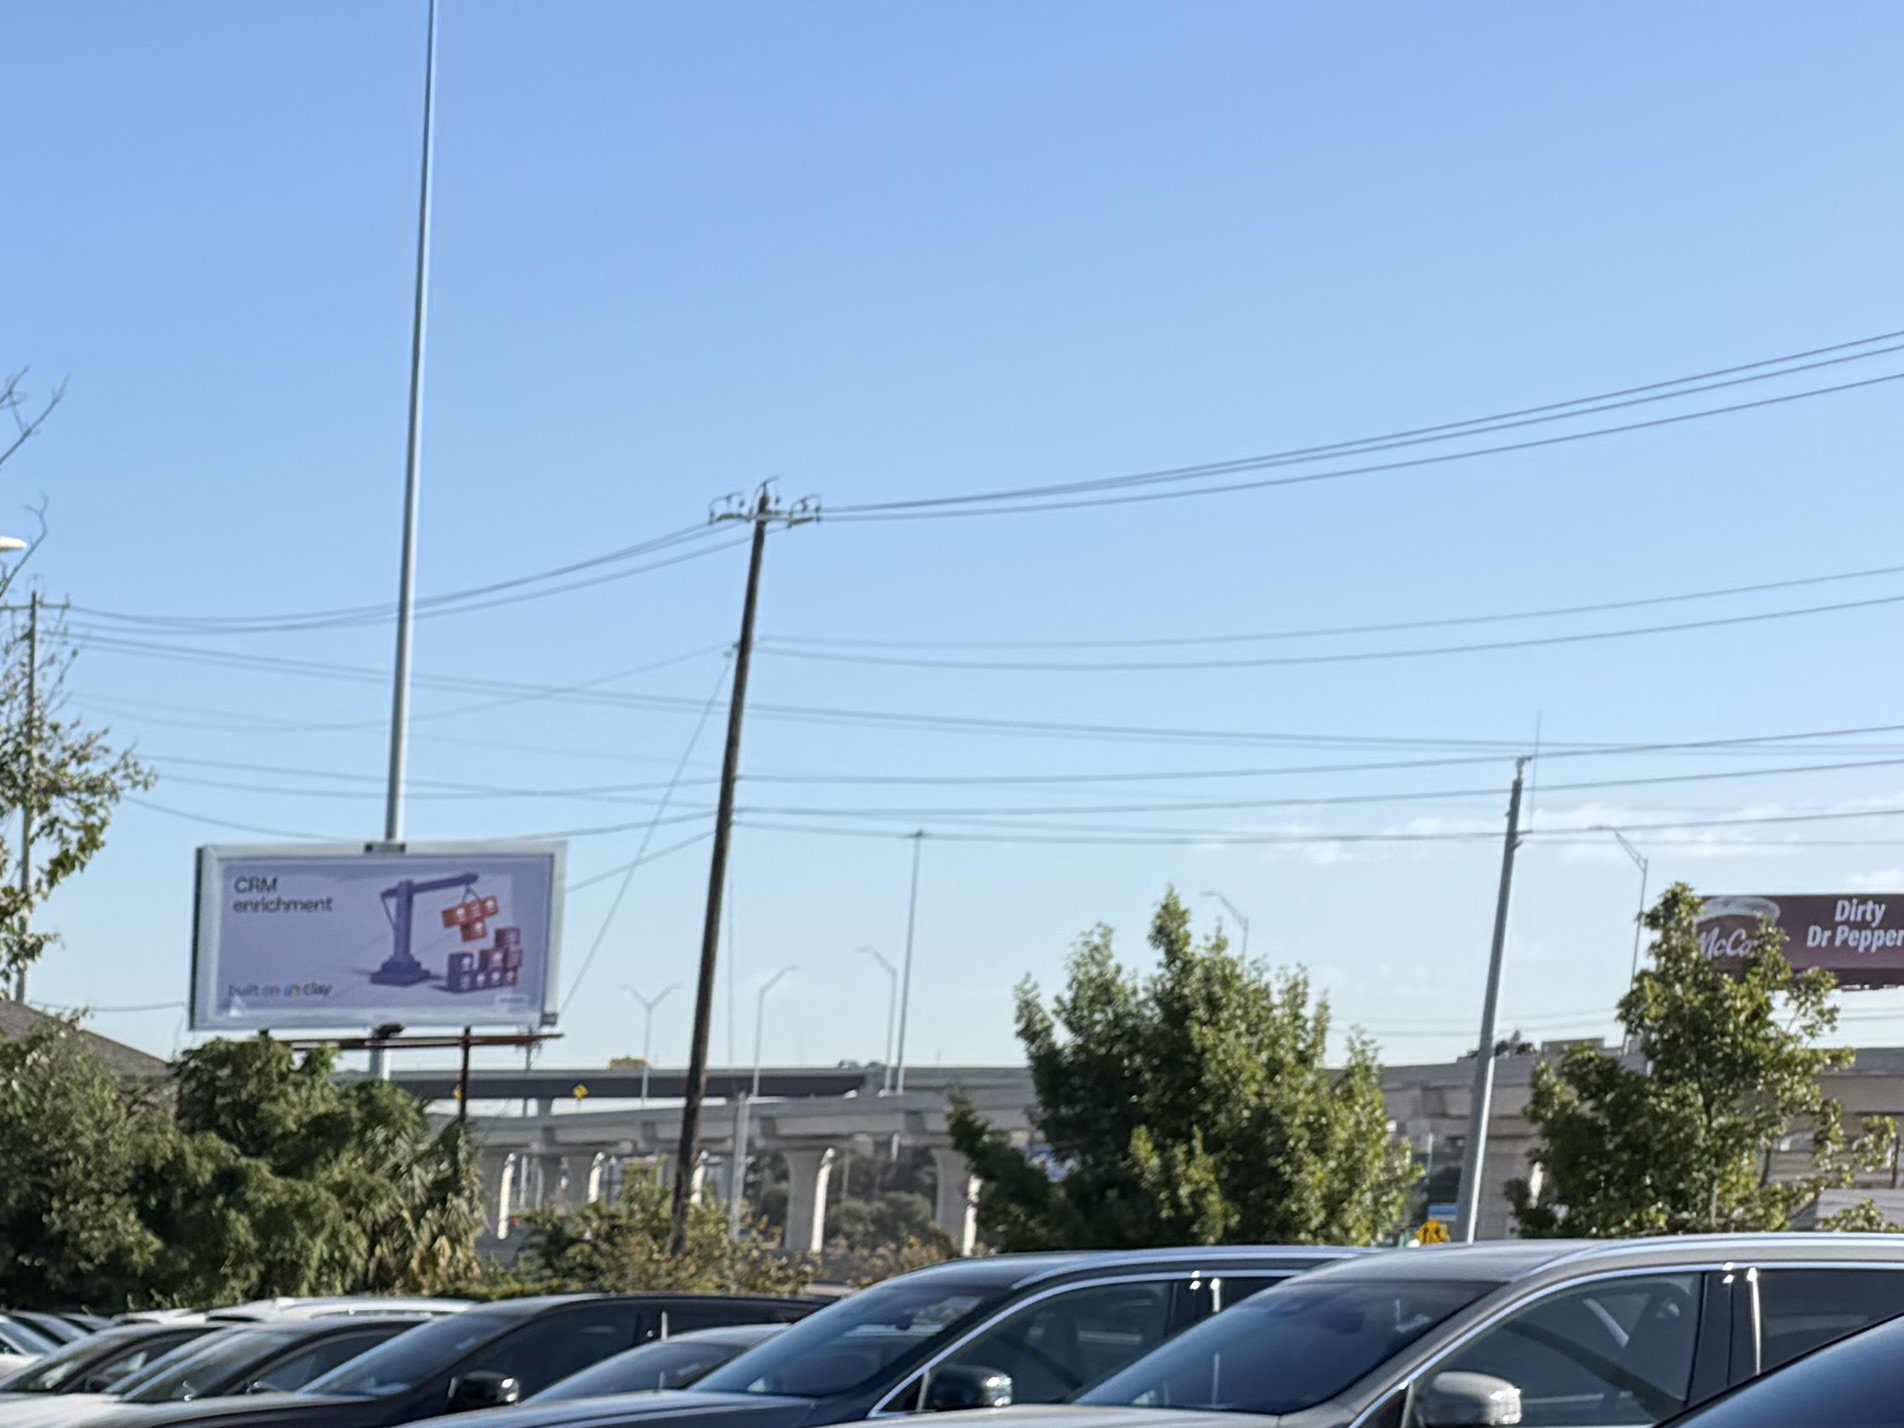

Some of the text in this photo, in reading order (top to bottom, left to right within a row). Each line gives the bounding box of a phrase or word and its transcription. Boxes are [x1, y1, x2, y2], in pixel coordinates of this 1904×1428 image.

[234, 876, 278, 893] CRM
[233, 897, 333, 913] enrichment
[1835, 898, 1886, 928] Dirty
[1807, 925, 1904, 953] Dr Pepper
